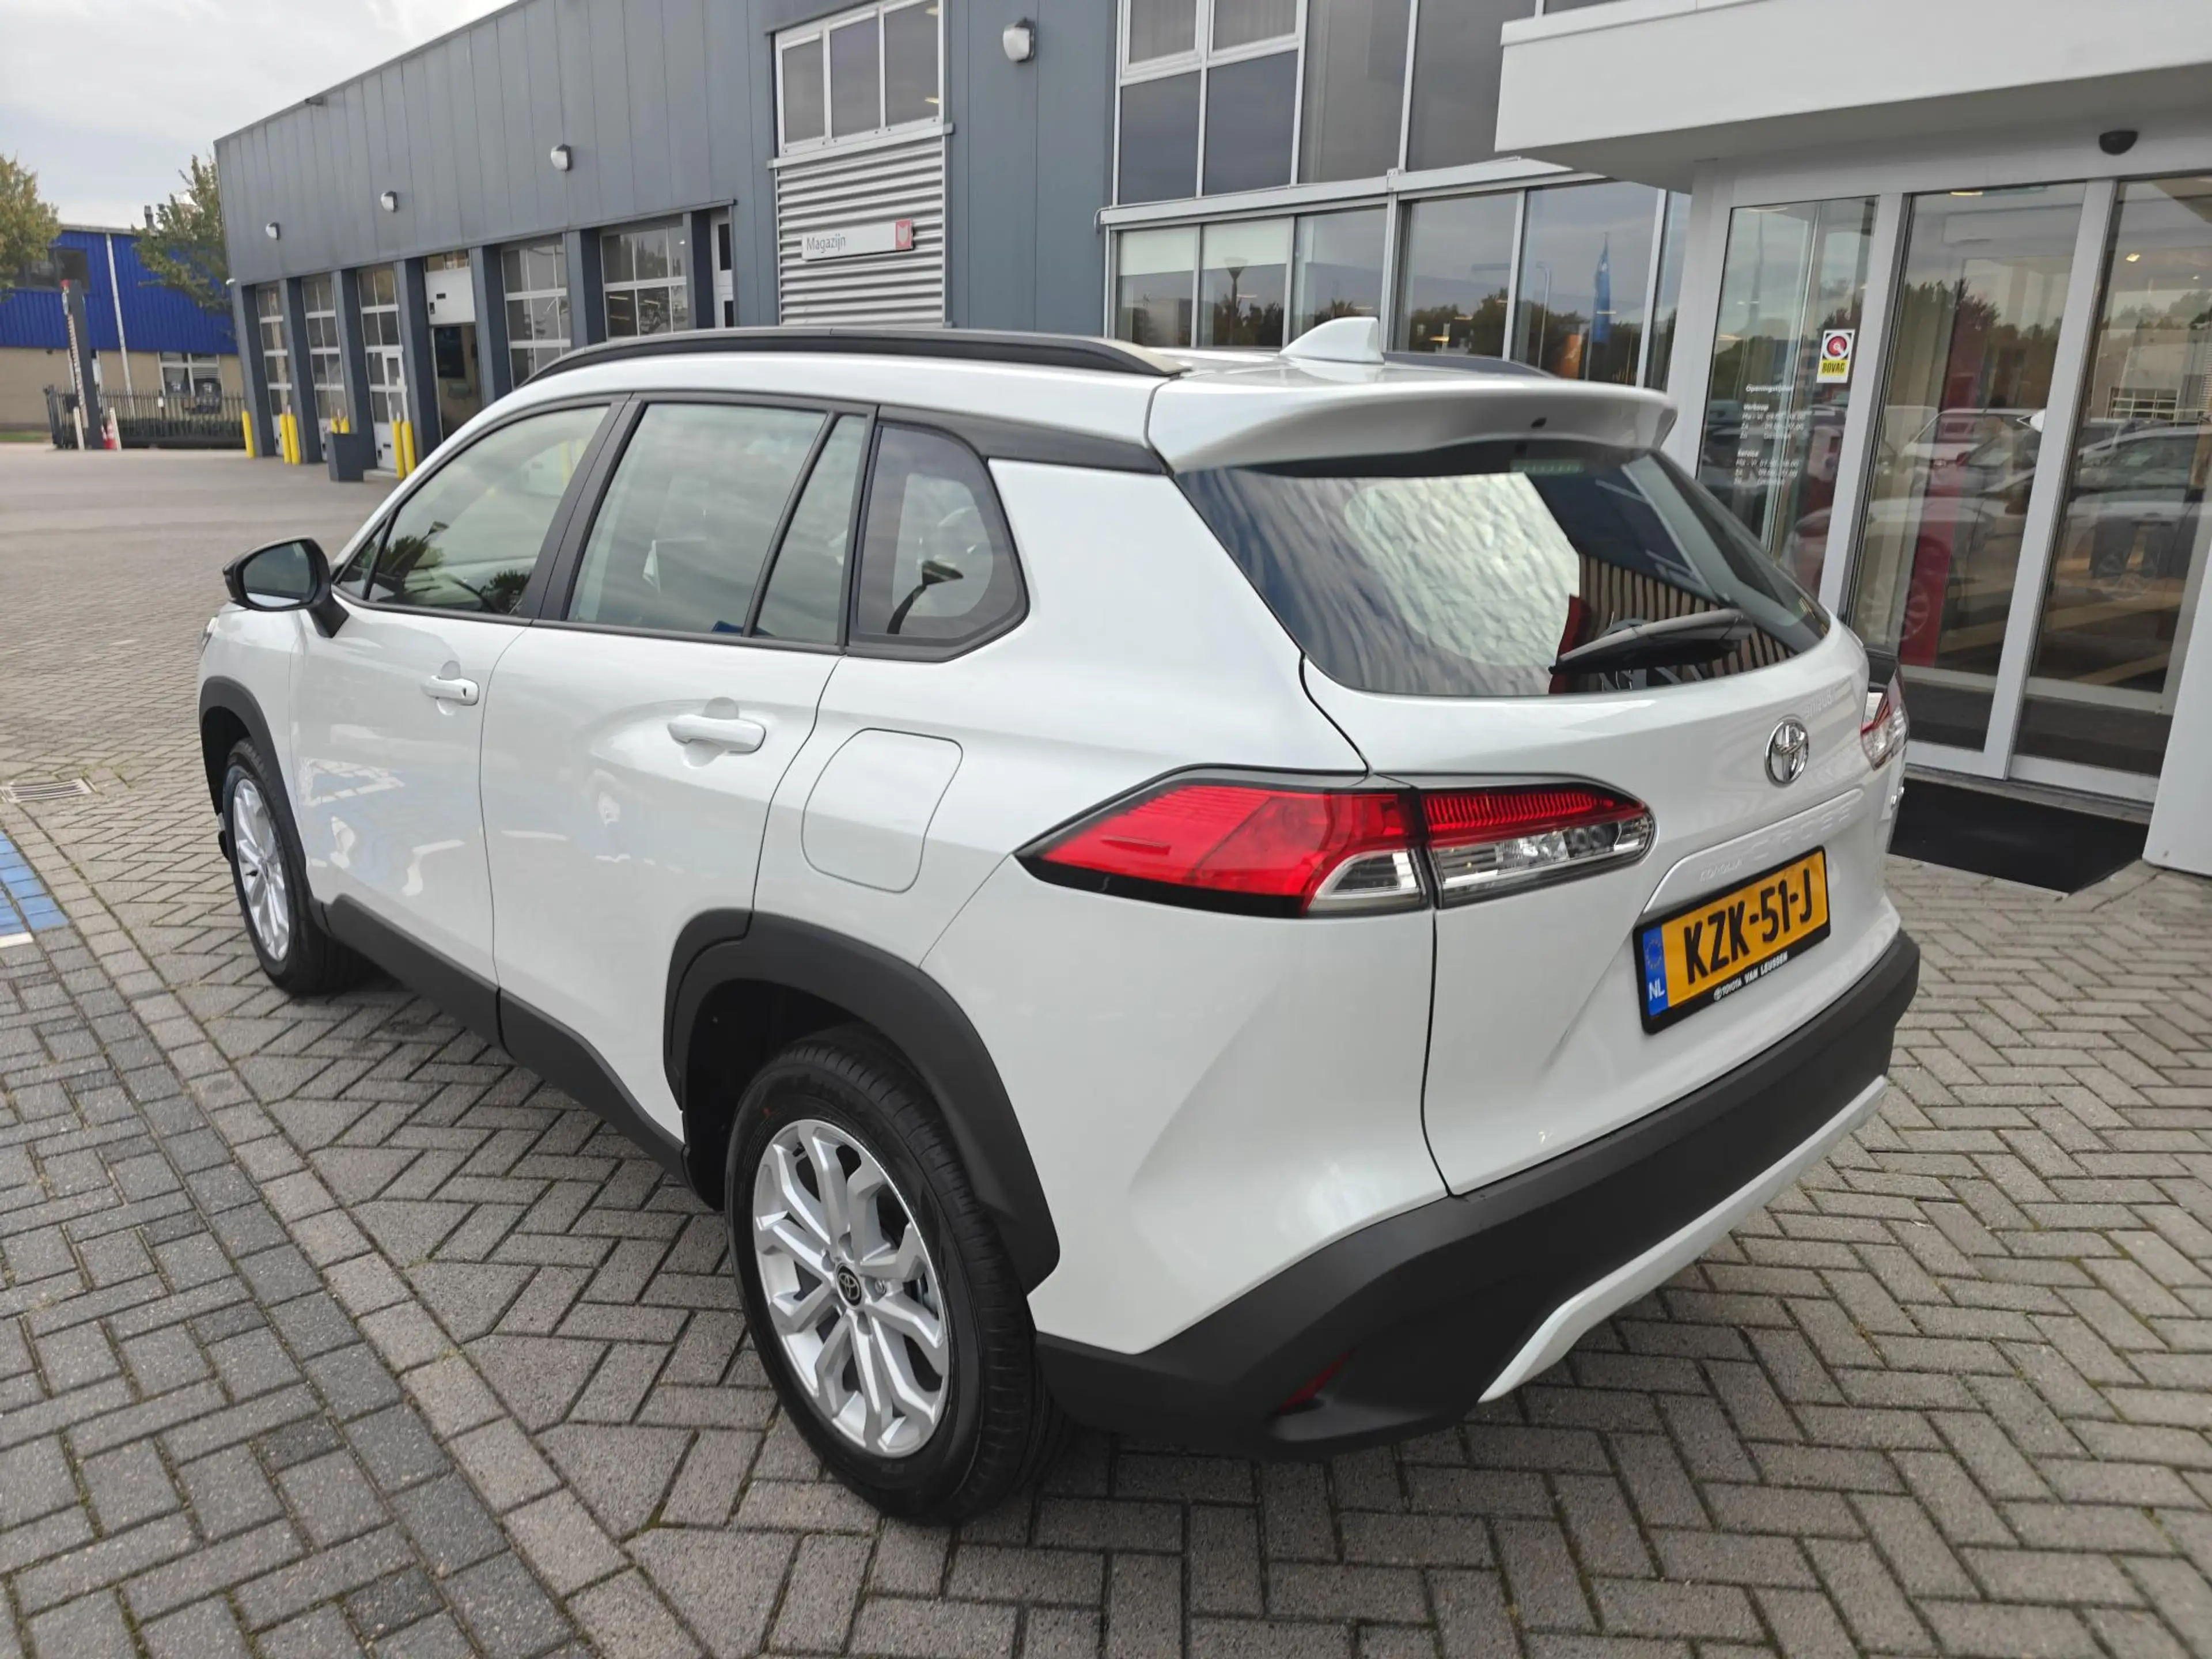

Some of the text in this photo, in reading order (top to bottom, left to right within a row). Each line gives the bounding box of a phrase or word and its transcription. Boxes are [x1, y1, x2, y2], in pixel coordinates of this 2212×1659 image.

[806, 233, 846, 253] Magazijn
[1822, 362, 1845, 373] BOVAG
[1683, 868, 1813, 986] KZK-51-J
[1648, 978, 1666, 1002] NL
[1722, 977, 1743, 996] TOYOTA
[1744, 967, 1759, 984] VAN
